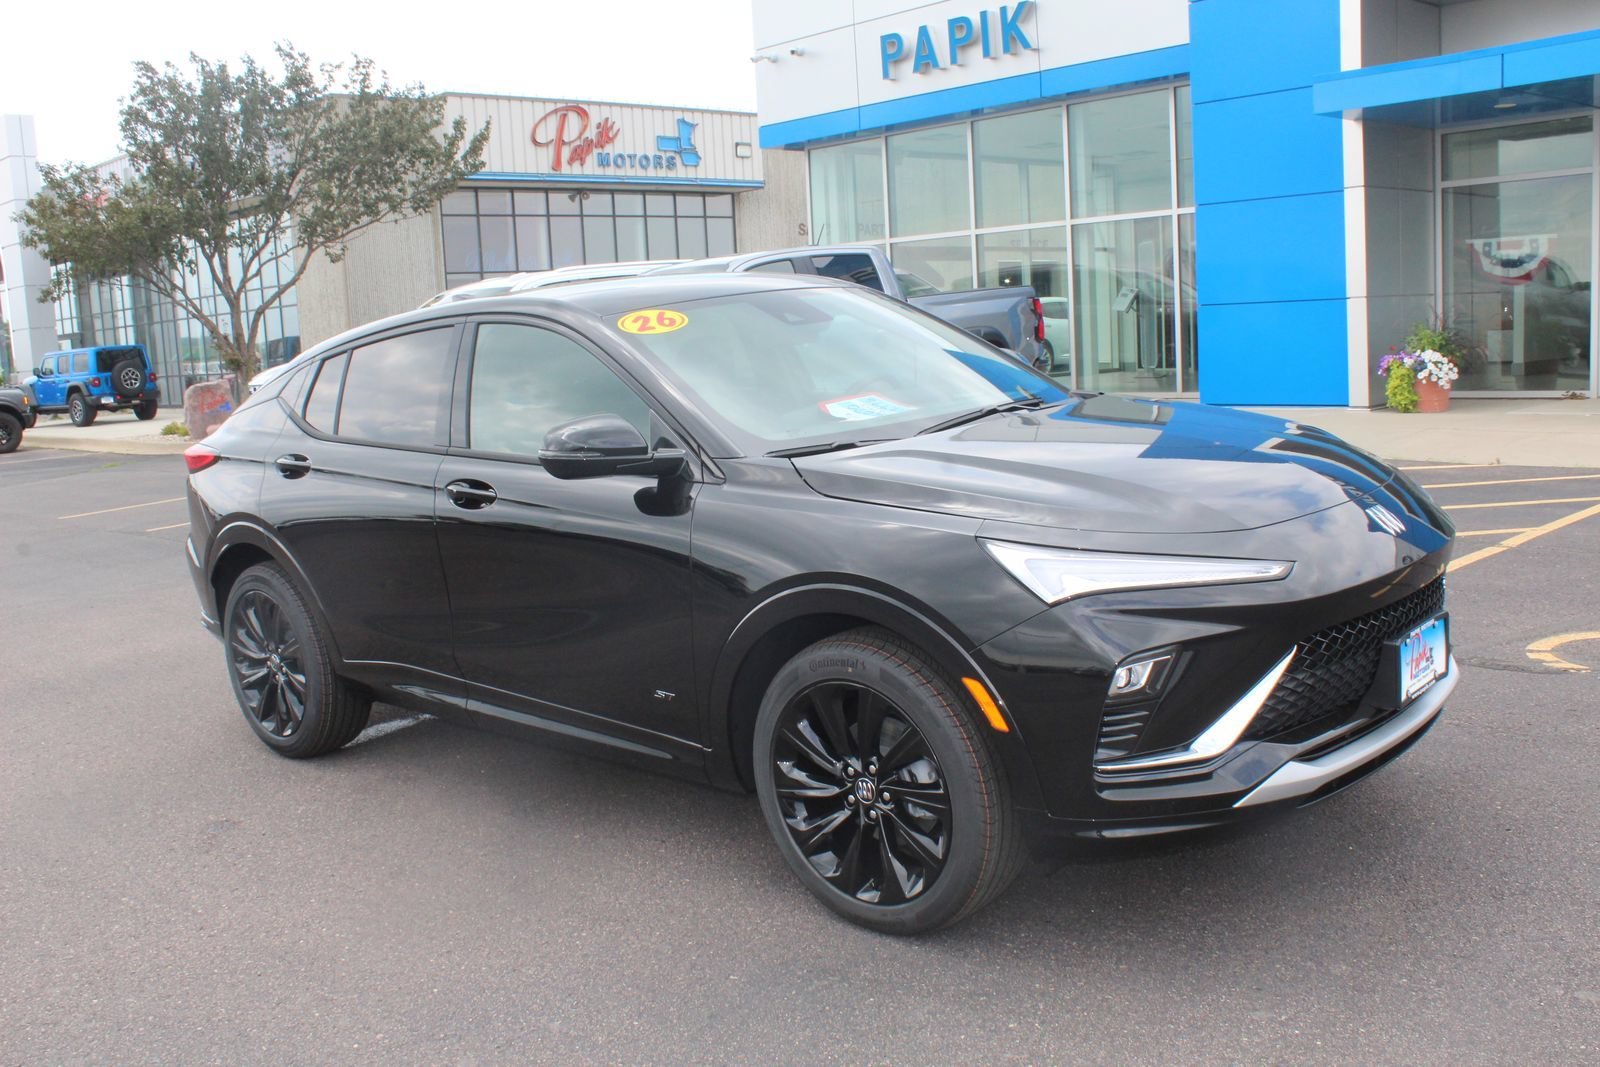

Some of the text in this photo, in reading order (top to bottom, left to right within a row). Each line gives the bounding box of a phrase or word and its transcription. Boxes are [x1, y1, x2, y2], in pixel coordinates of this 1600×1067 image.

[880, 0, 1034, 80] PAPIK
[531, 104, 621, 171] Papik
[597, 152, 678, 171] MOTORS
[631, 311, 677, 332] 26
[809, 656, 859, 672] Continental
